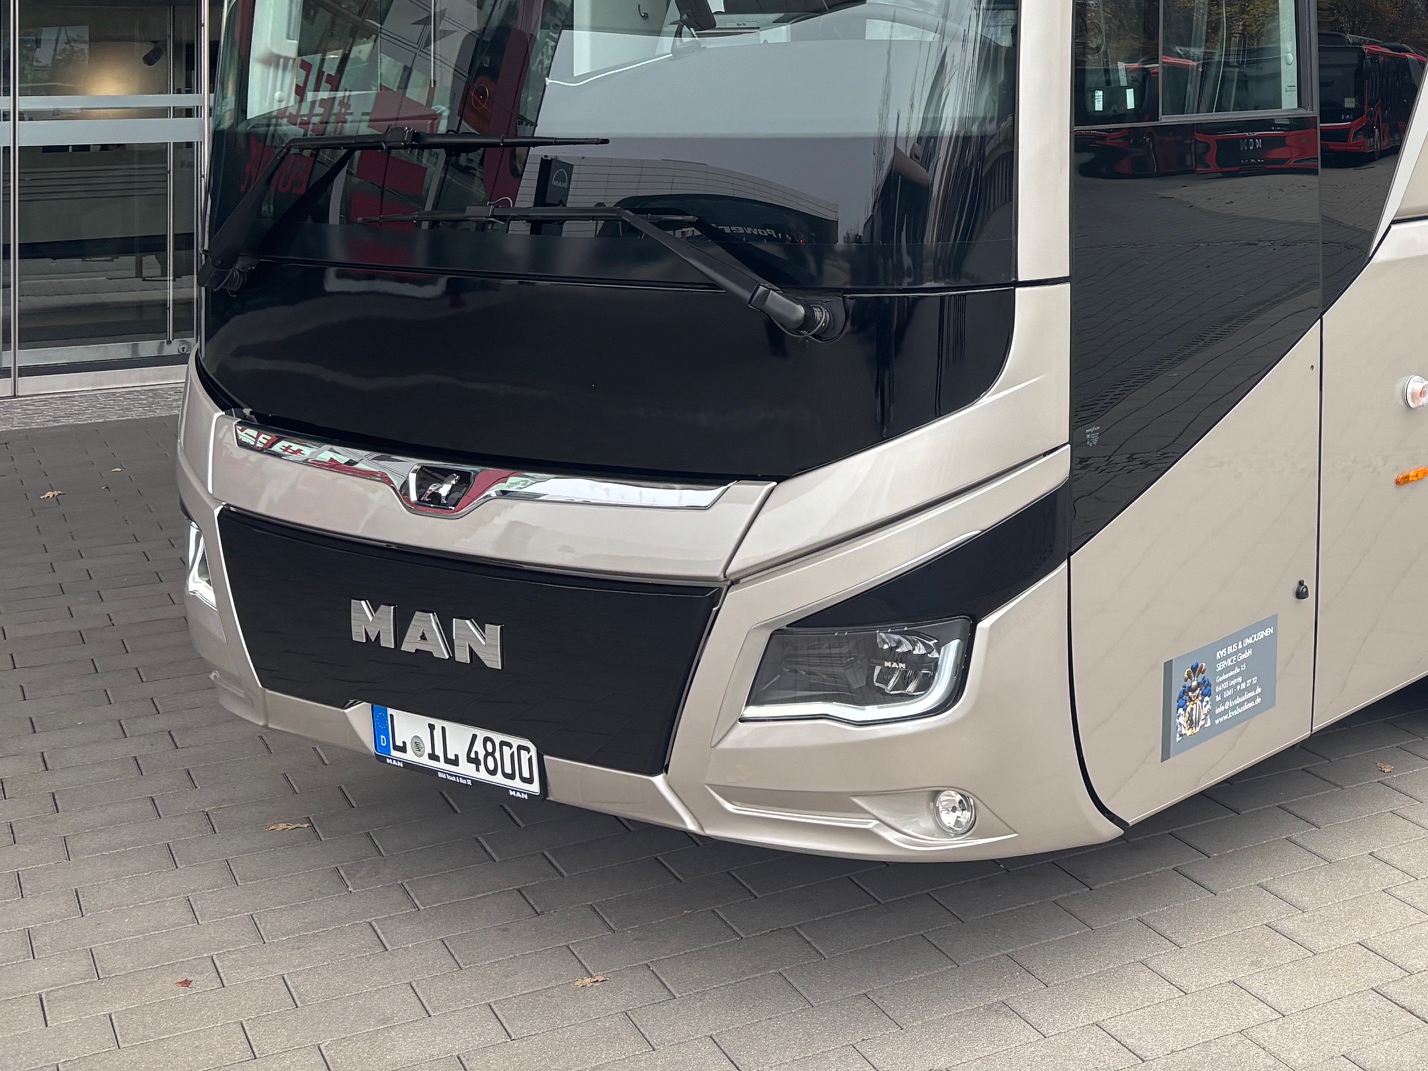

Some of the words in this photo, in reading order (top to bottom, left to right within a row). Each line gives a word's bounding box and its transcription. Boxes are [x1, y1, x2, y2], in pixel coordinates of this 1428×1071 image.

[350, 598, 505, 670] MAN
[1227, 644, 1238, 655] BUS
[1238, 641, 1243, 650] &
[1243, 626, 1274, 647] LIMOUSINEN
[884, 661, 906, 669] MAN
[1215, 655, 1236, 672] SERVICE
[1236, 648, 1253, 662] GmbH
[380, 734, 387, 747] D
[389, 713, 408, 754] L
[427, 722, 460, 767] IL
[466, 733, 535, 785] 4800
[386, 758, 404, 768] MAN
[509, 789, 529, 800] MAN
